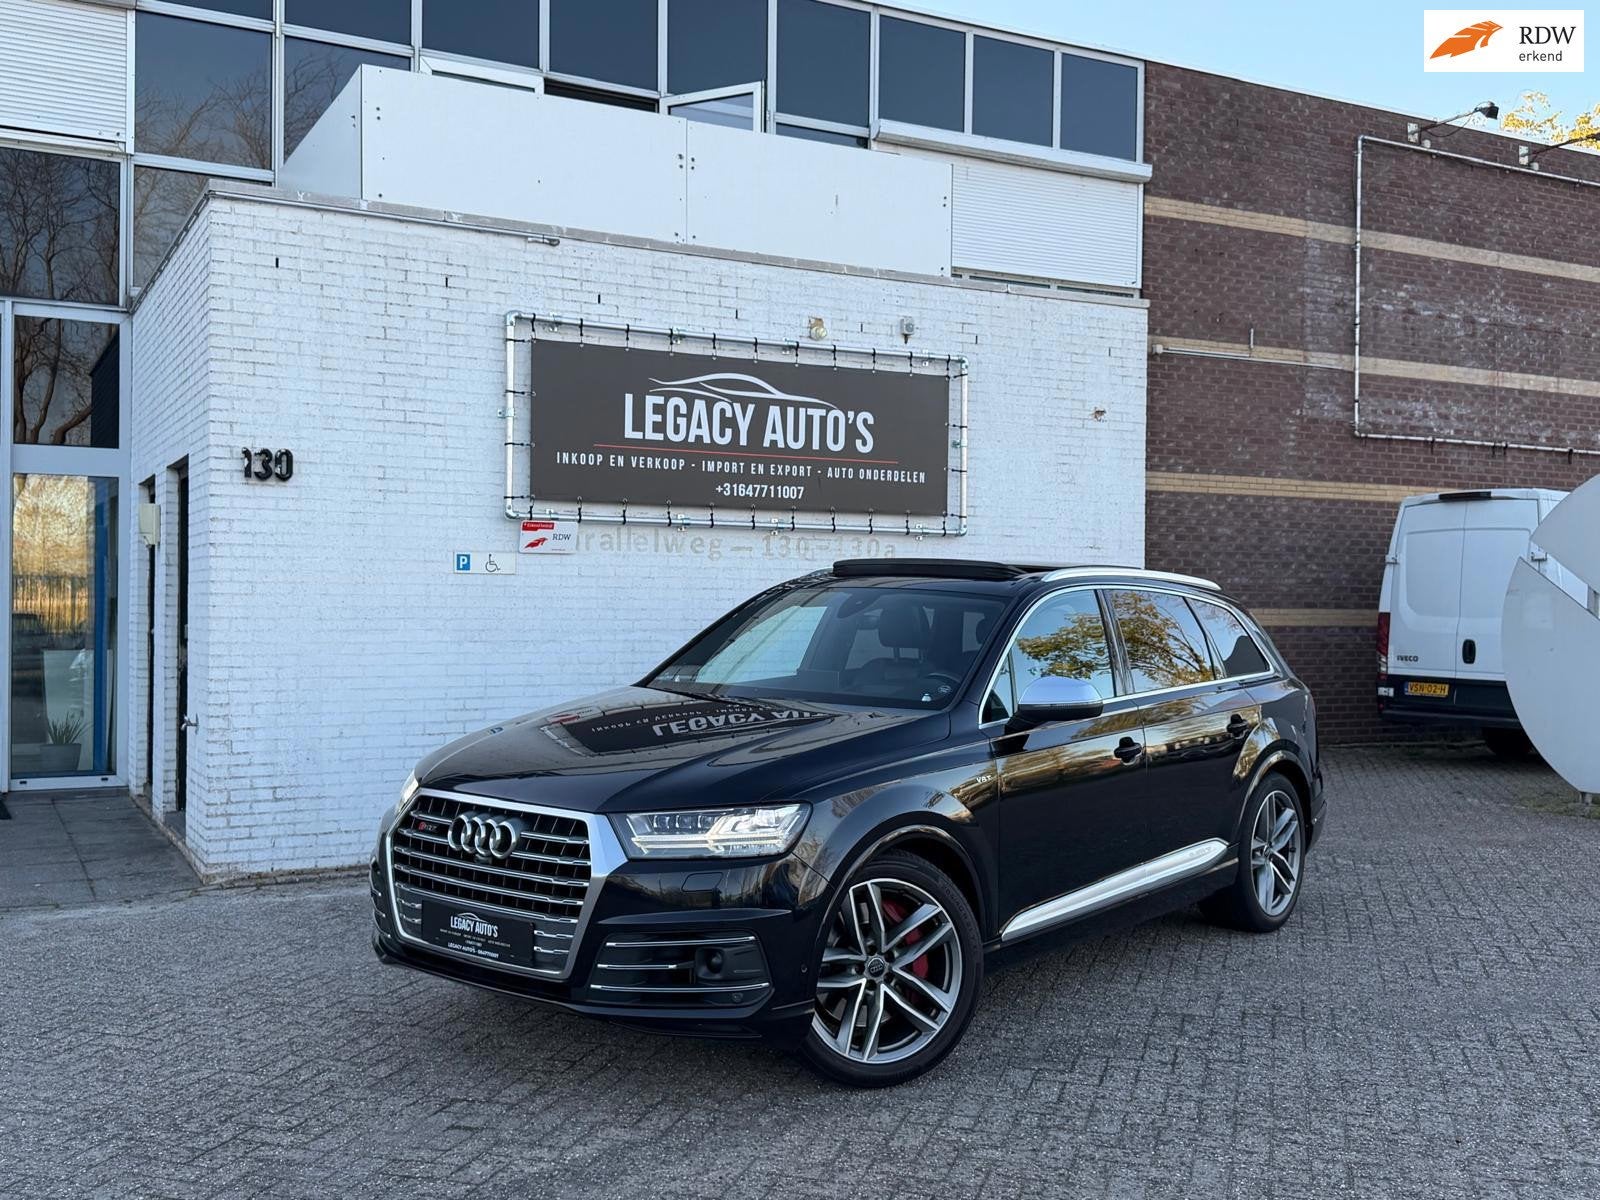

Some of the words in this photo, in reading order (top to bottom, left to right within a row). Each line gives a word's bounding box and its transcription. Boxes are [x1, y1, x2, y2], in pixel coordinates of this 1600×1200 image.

[624, 393, 756, 447] LEGACY
[762, 404, 875, 454] AUTO'S
[241, 446, 294, 482] 130
[556, 451, 603, 466] INKOOP
[609, 454, 625, 468] EN
[630, 456, 686, 471] VERKOOP
[702, 460, 744, 474] IMPORT
[750, 462, 765, 475] EN
[770, 463, 812, 477] EXPORT
[826, 467, 854, 480] AUTO
[858, 468, 926, 484] ONDERDELEN
[715, 482, 805, 500] +31647711007
[552, 533, 571, 541] RDW
[576, 527, 723, 562] rallelweg
[450, 915, 475, 933] LEGACY
[475, 920, 500, 938] AUTO'S
